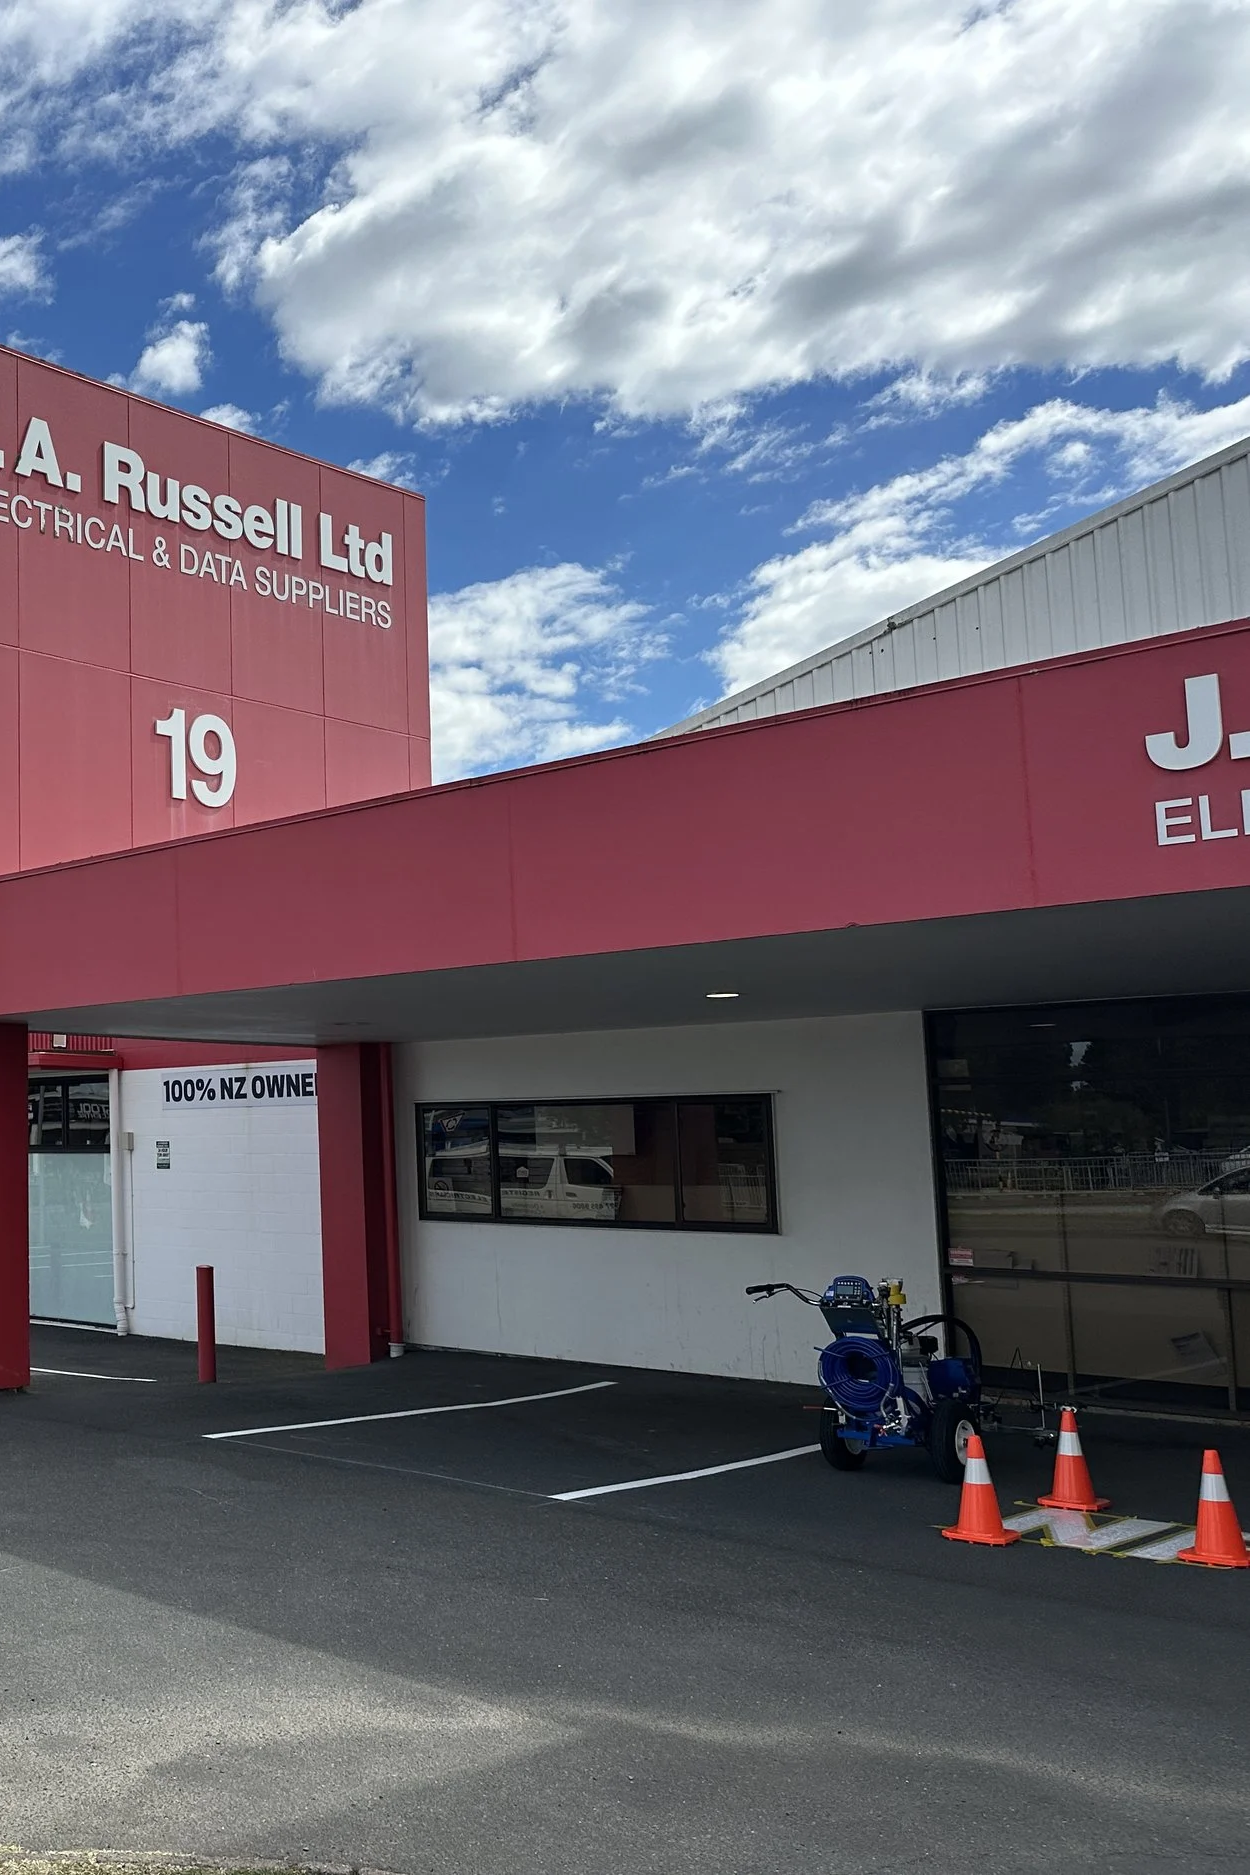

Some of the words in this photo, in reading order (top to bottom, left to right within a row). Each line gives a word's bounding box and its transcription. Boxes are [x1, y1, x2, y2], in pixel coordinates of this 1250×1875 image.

[103, 441, 303, 560] Russell
[319, 511, 393, 586] Ltd
[152, 536, 171, 569] &
[180, 543, 248, 591] DATA
[254, 566, 392, 630] SUPPLIERS
[155, 708, 237, 808] 19
[1155, 788, 1250, 846] EL
[163, 1078, 216, 1102] 100%
[220, 1077, 248, 1100] NZ
